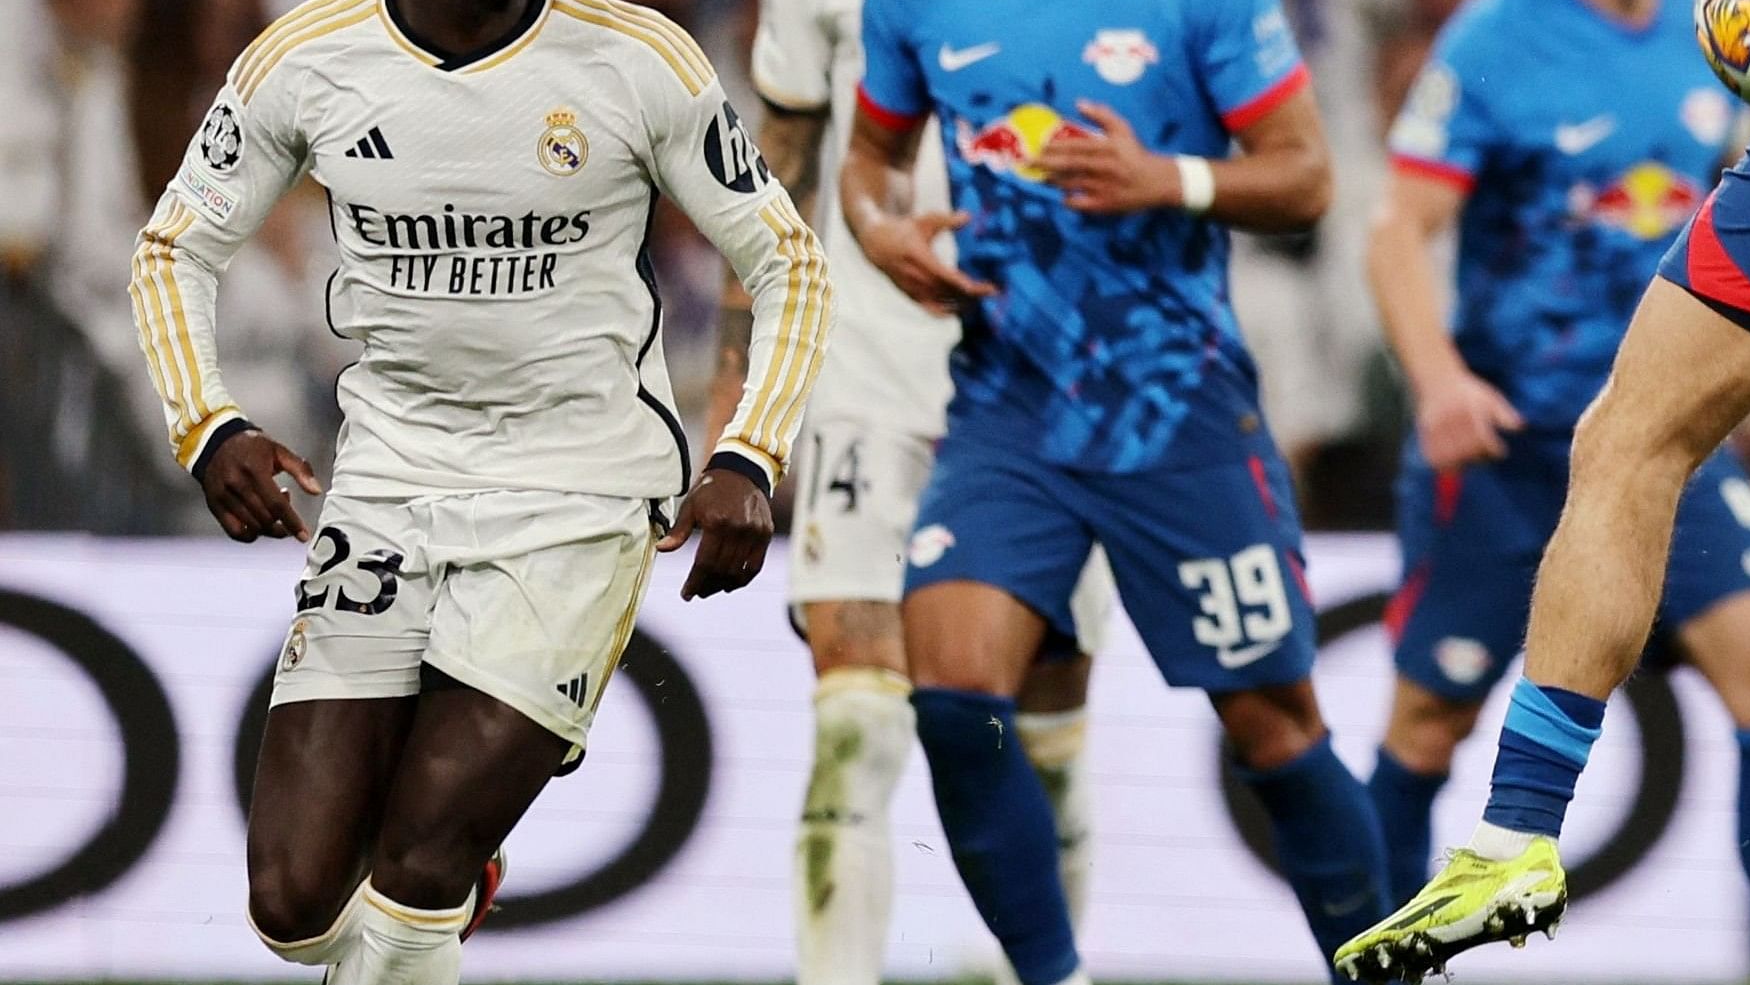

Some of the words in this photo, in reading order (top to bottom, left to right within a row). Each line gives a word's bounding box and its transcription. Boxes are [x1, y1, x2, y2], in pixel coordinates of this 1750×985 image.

[347, 203, 591, 250] Emirates
[391, 253, 438, 292] FLY
[449, 253, 557, 295] BETTER
[807, 433, 871, 512] 14
[297, 526, 404, 616] 23
[1178, 543, 1293, 648] 39
